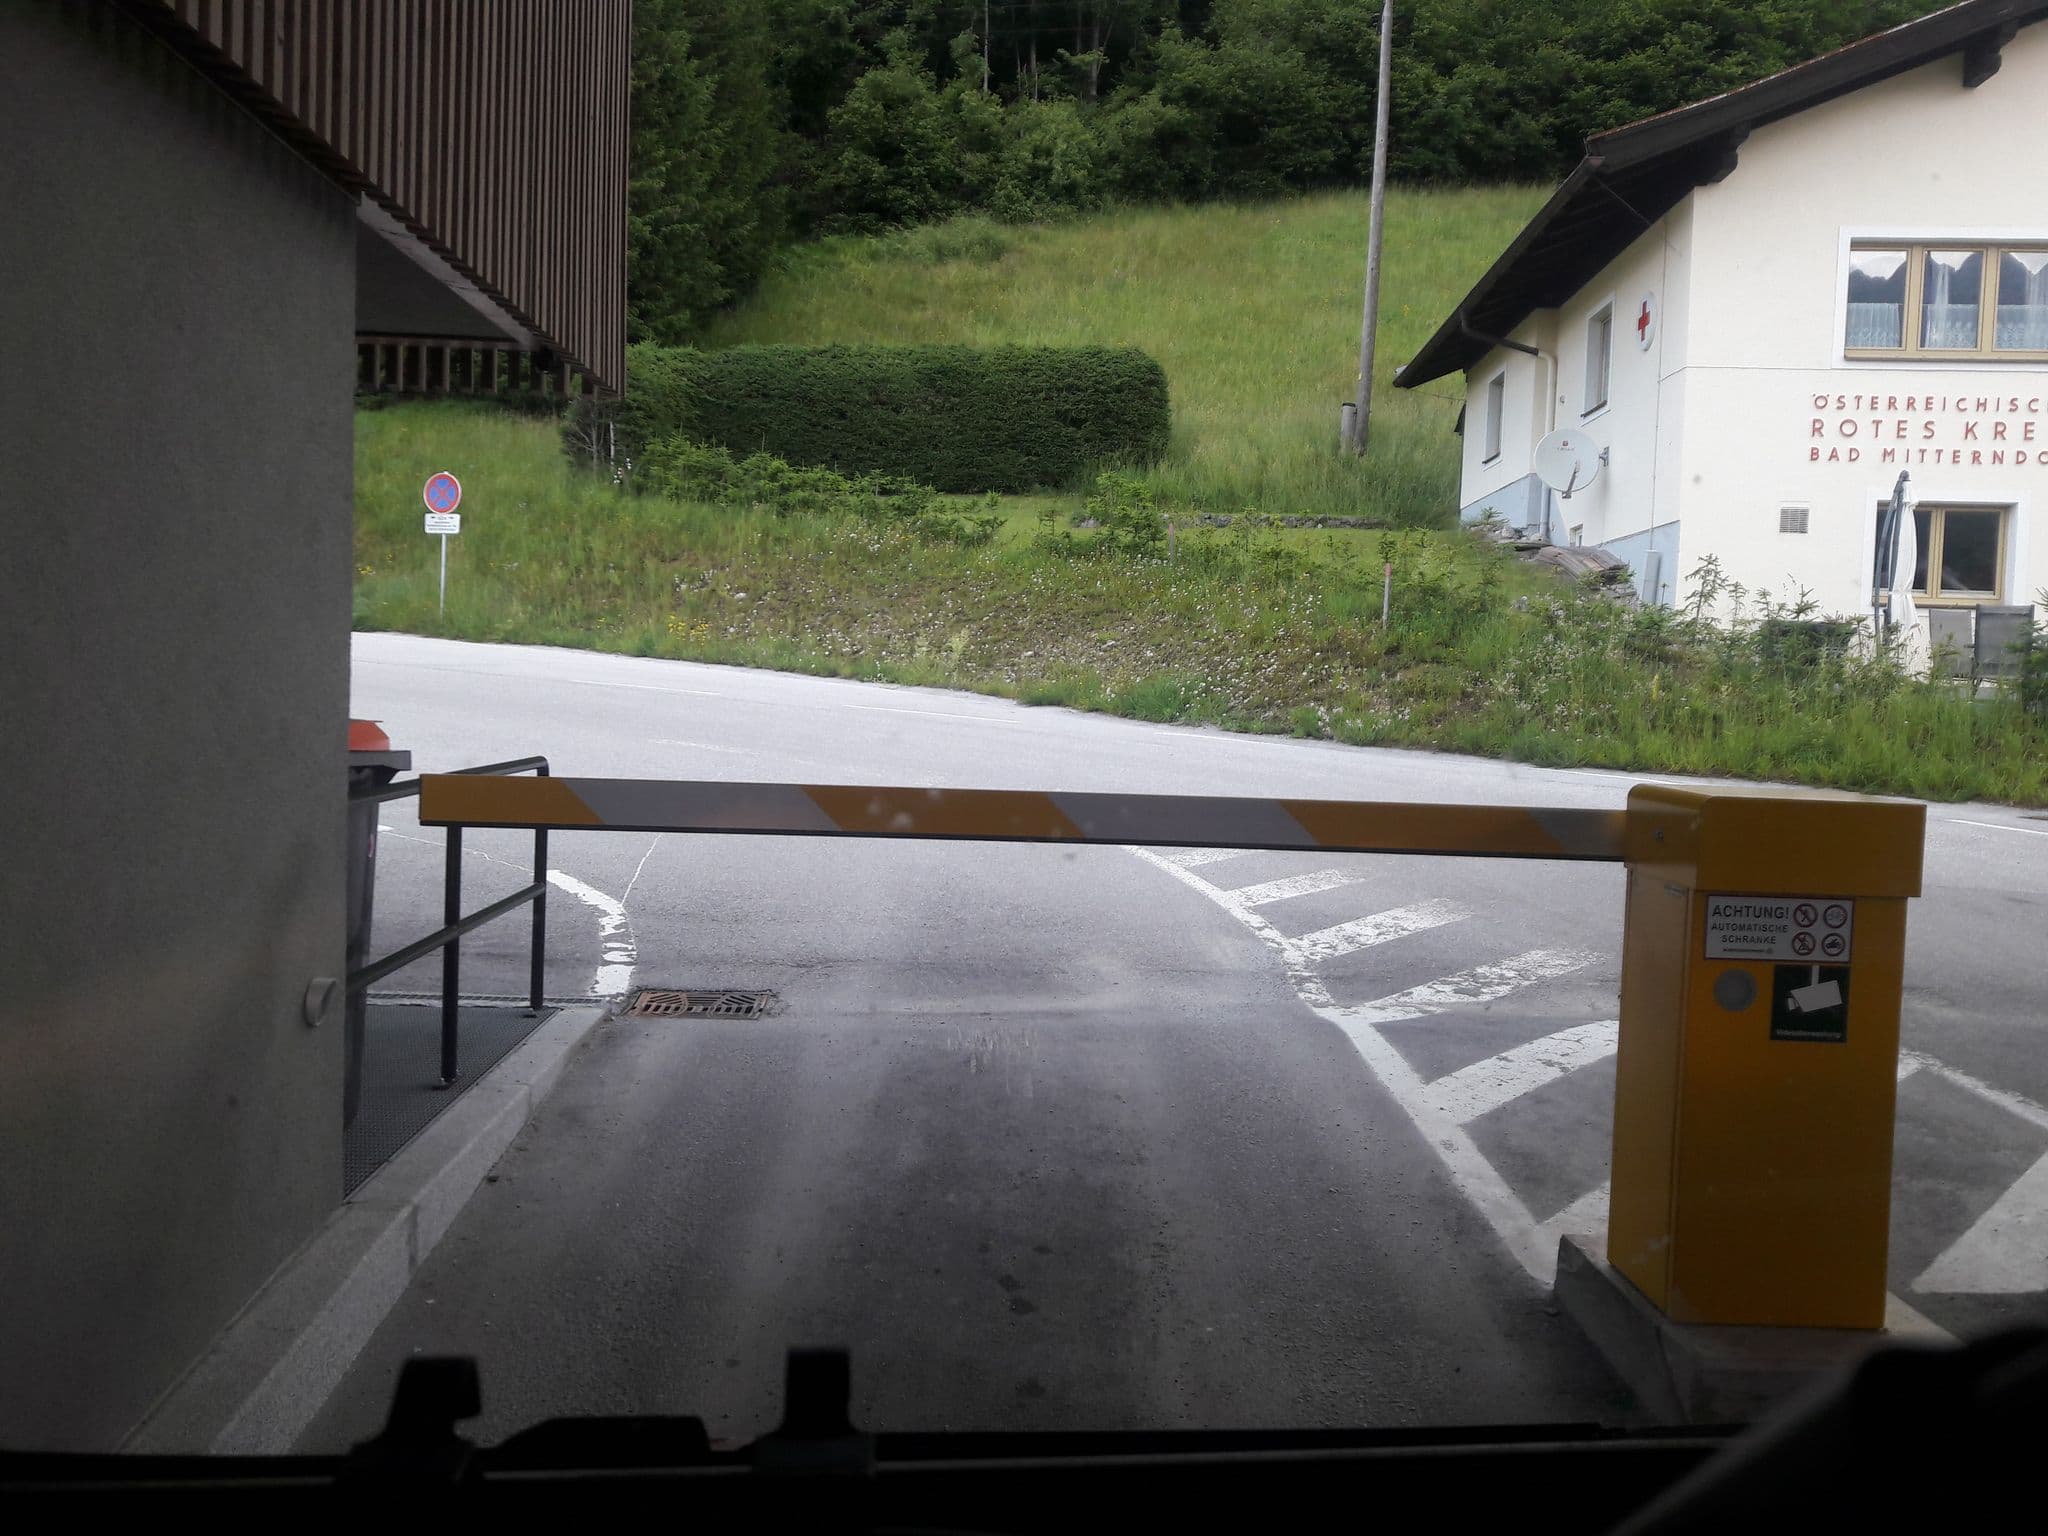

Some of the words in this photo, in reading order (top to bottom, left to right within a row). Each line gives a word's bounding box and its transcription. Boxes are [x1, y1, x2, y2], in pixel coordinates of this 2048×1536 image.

[1812, 393, 2048, 412] ÖSTERREICHISC
[1811, 418, 1936, 439] ROTES
[1963, 420, 2036, 441] KRE
[1810, 447, 1861, 462] BAD
[1711, 904, 1790, 919] ACHTUNG!
[1711, 922, 1789, 933] AUTOMATISCHE
[1720, 934, 1777, 944] SCHRANKE
